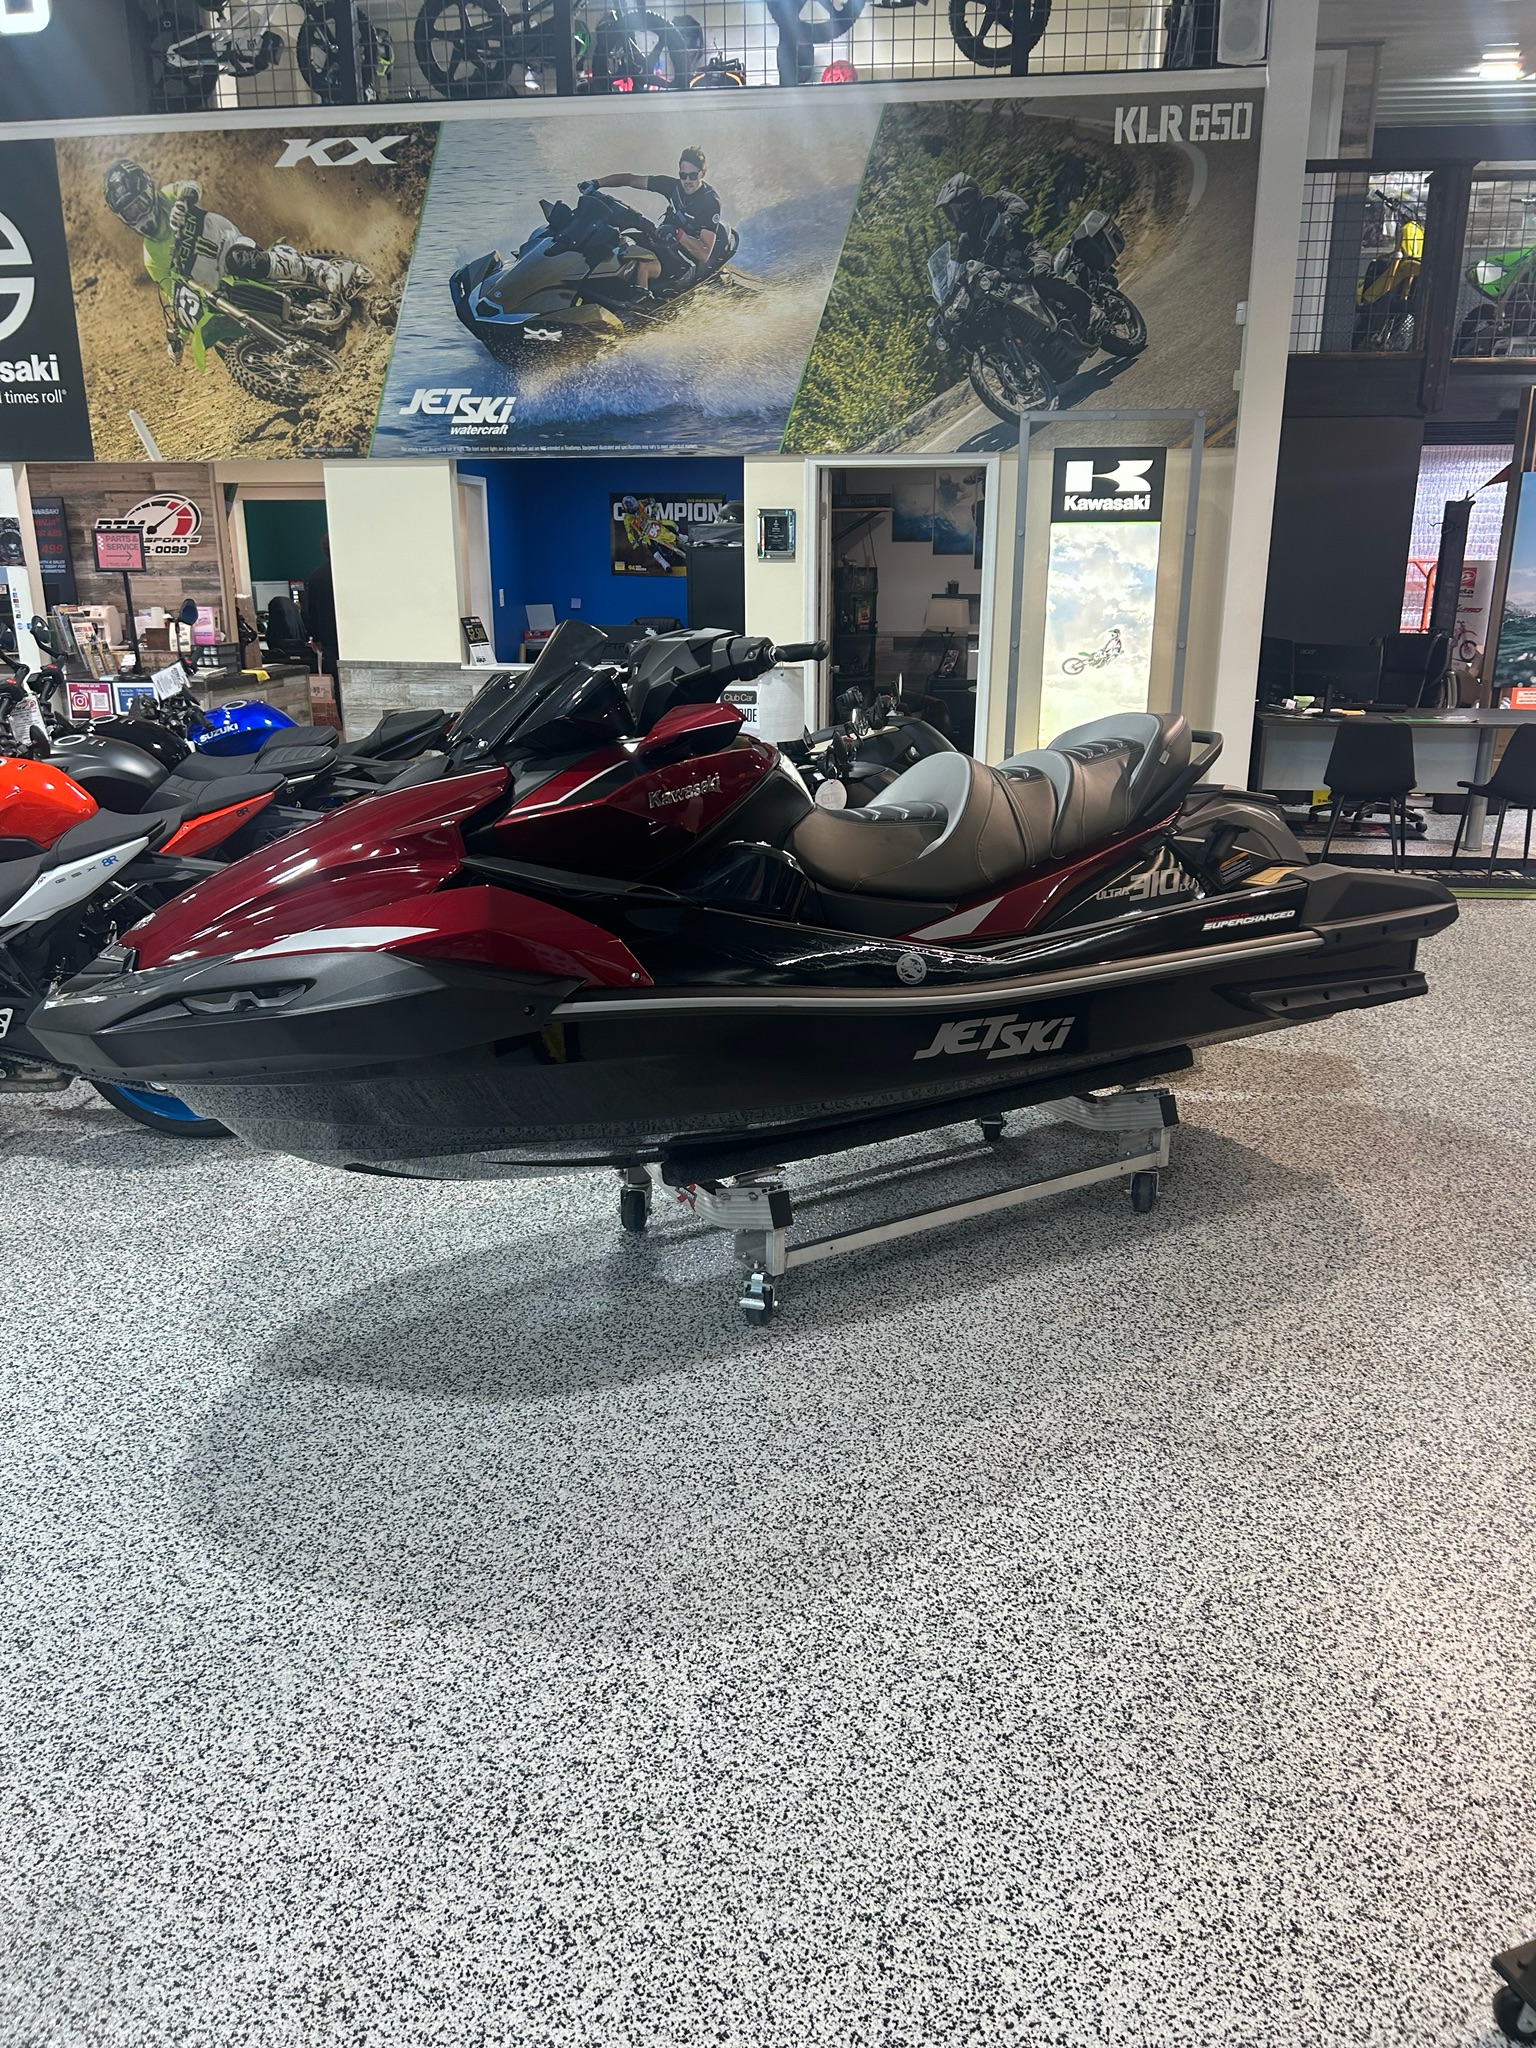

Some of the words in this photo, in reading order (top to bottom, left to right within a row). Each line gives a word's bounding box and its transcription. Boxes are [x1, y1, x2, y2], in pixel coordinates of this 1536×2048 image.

[1113, 105, 1184, 145] KLR
[1189, 102, 1254, 142] 650
[274, 135, 409, 168] KX
[0, 354, 60, 383] saki
[4, 390, 39, 404] times
[450, 425, 509, 436] watercraft
[613, 502, 722, 521] CMPION
[1063, 494, 1151, 511] Kawasaki
[105, 535, 131, 543] PARTS
[132, 535, 139, 543] &
[723, 693, 741, 702] Club
[741, 693, 754, 702] Car
[200, 723, 239, 742] SUZUKI
[286, 786, 295, 794] 8T
[648, 772, 721, 808] Kawasaki
[236, 807, 250, 817] 8R
[102, 855, 119, 867] 8R
[1129, 868, 1180, 902] 310
[1202, 910, 1296, 932] SUPERCHARGED
